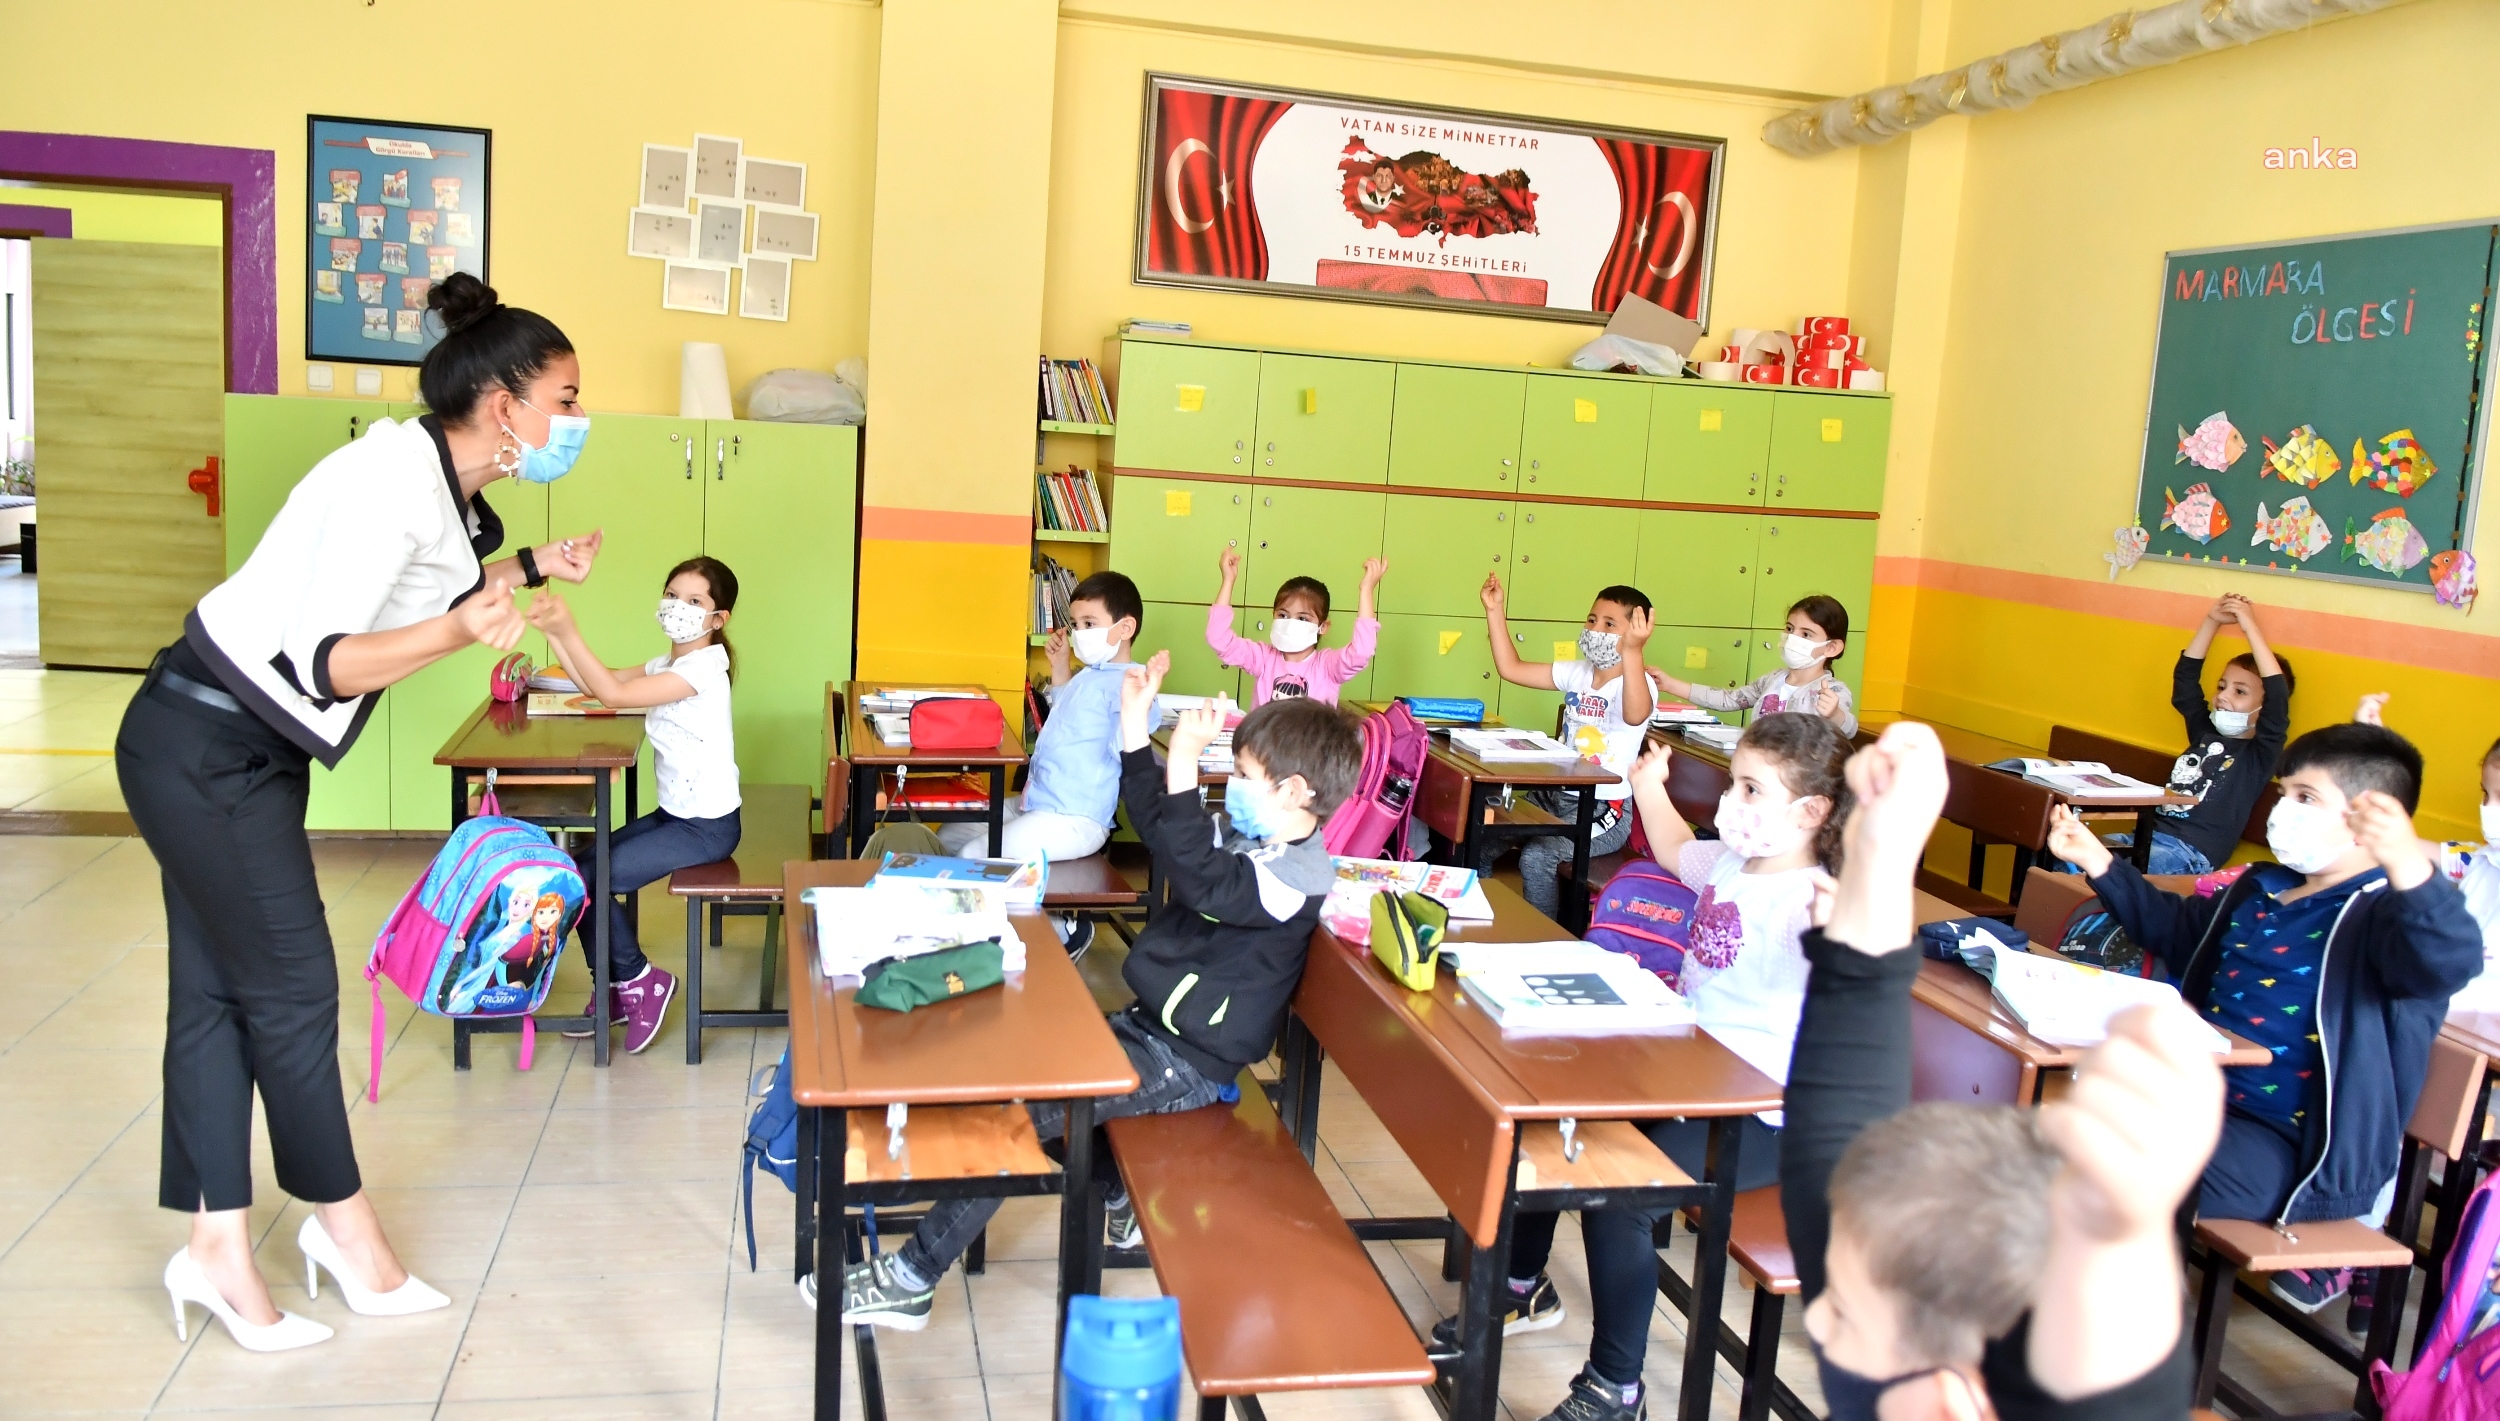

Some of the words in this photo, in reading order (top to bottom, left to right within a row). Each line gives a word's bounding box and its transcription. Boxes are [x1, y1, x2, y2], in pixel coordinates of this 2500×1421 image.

[1341, 116, 1395, 134] VATAN
[1344, 244, 1361, 257] 15
[1367, 246, 1436, 265] TEMMUZ
[2174, 260, 2325, 302] MARMARA
[478, 995, 517, 1004] FROZEN
